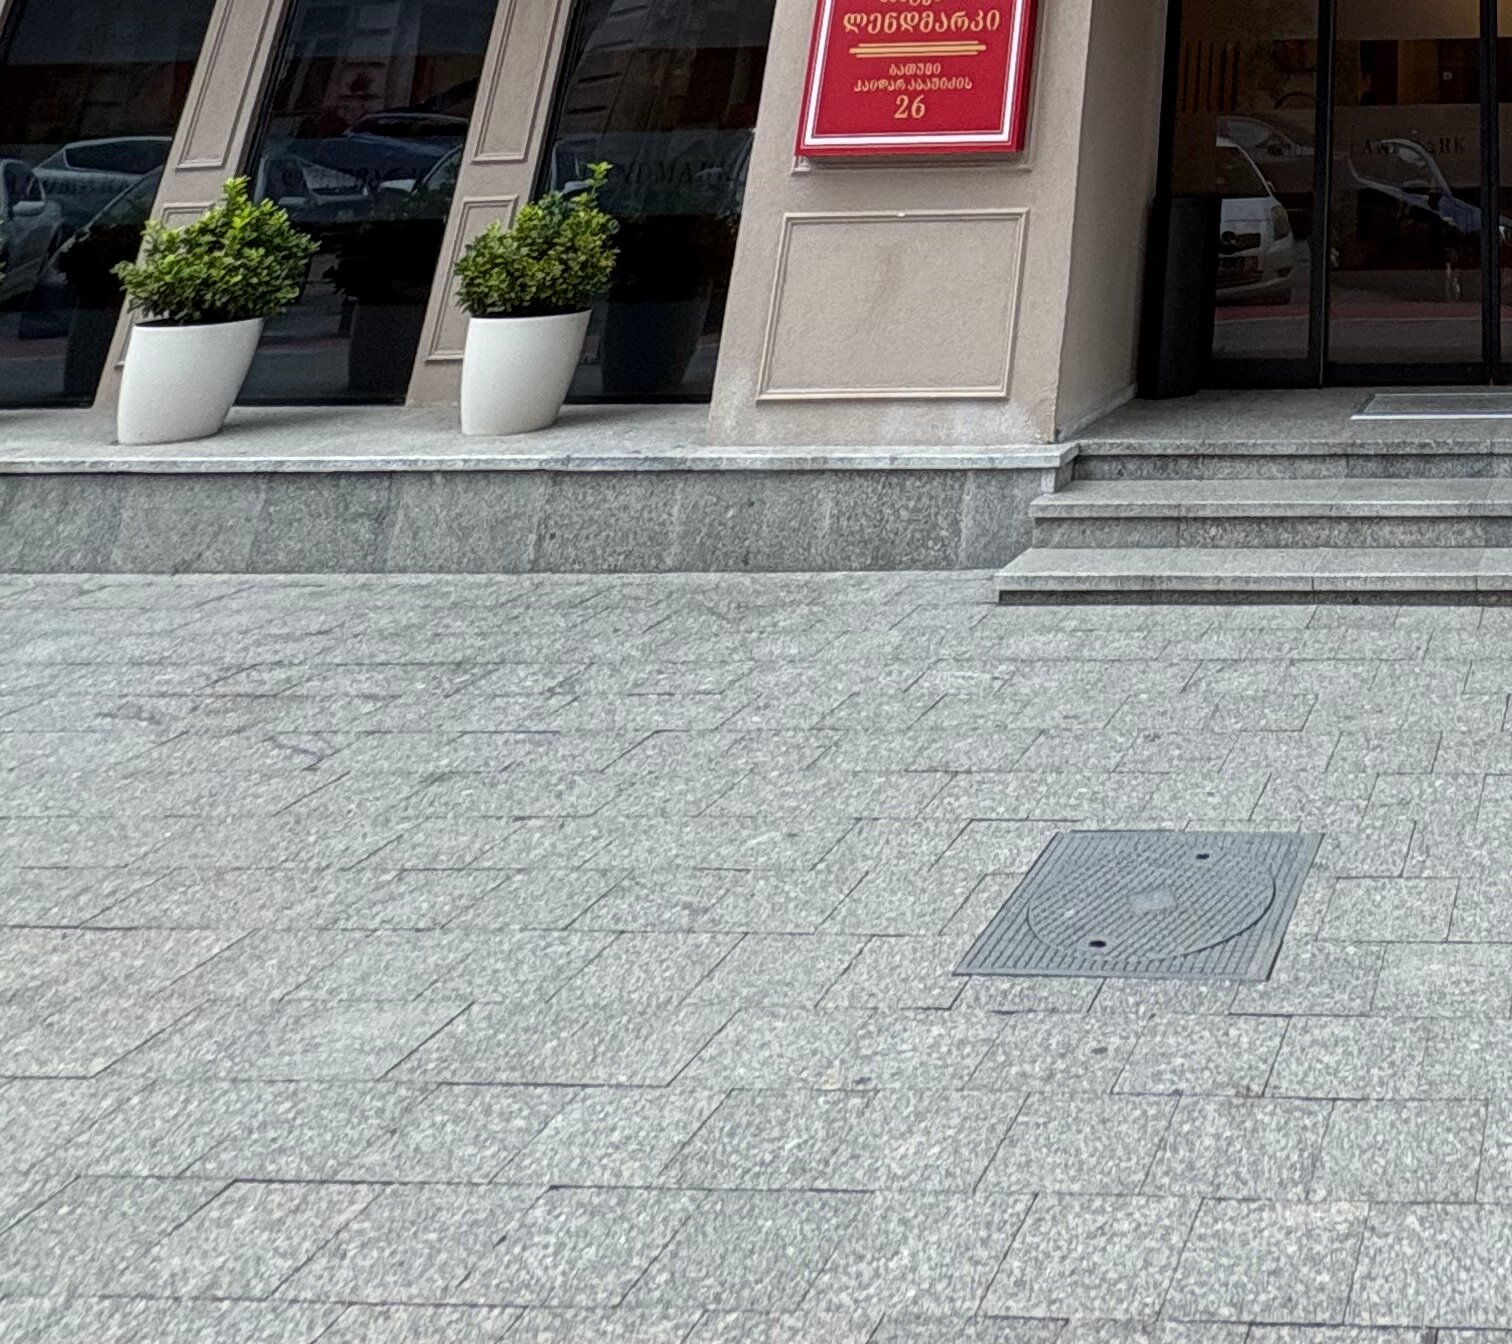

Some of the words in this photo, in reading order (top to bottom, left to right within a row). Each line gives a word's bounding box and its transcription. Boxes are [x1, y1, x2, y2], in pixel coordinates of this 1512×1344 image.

[843, 9, 1000, 34] ლენდმარკი
[888, 62, 942, 77] ბათუმი
[893, 93, 926, 119] 26
